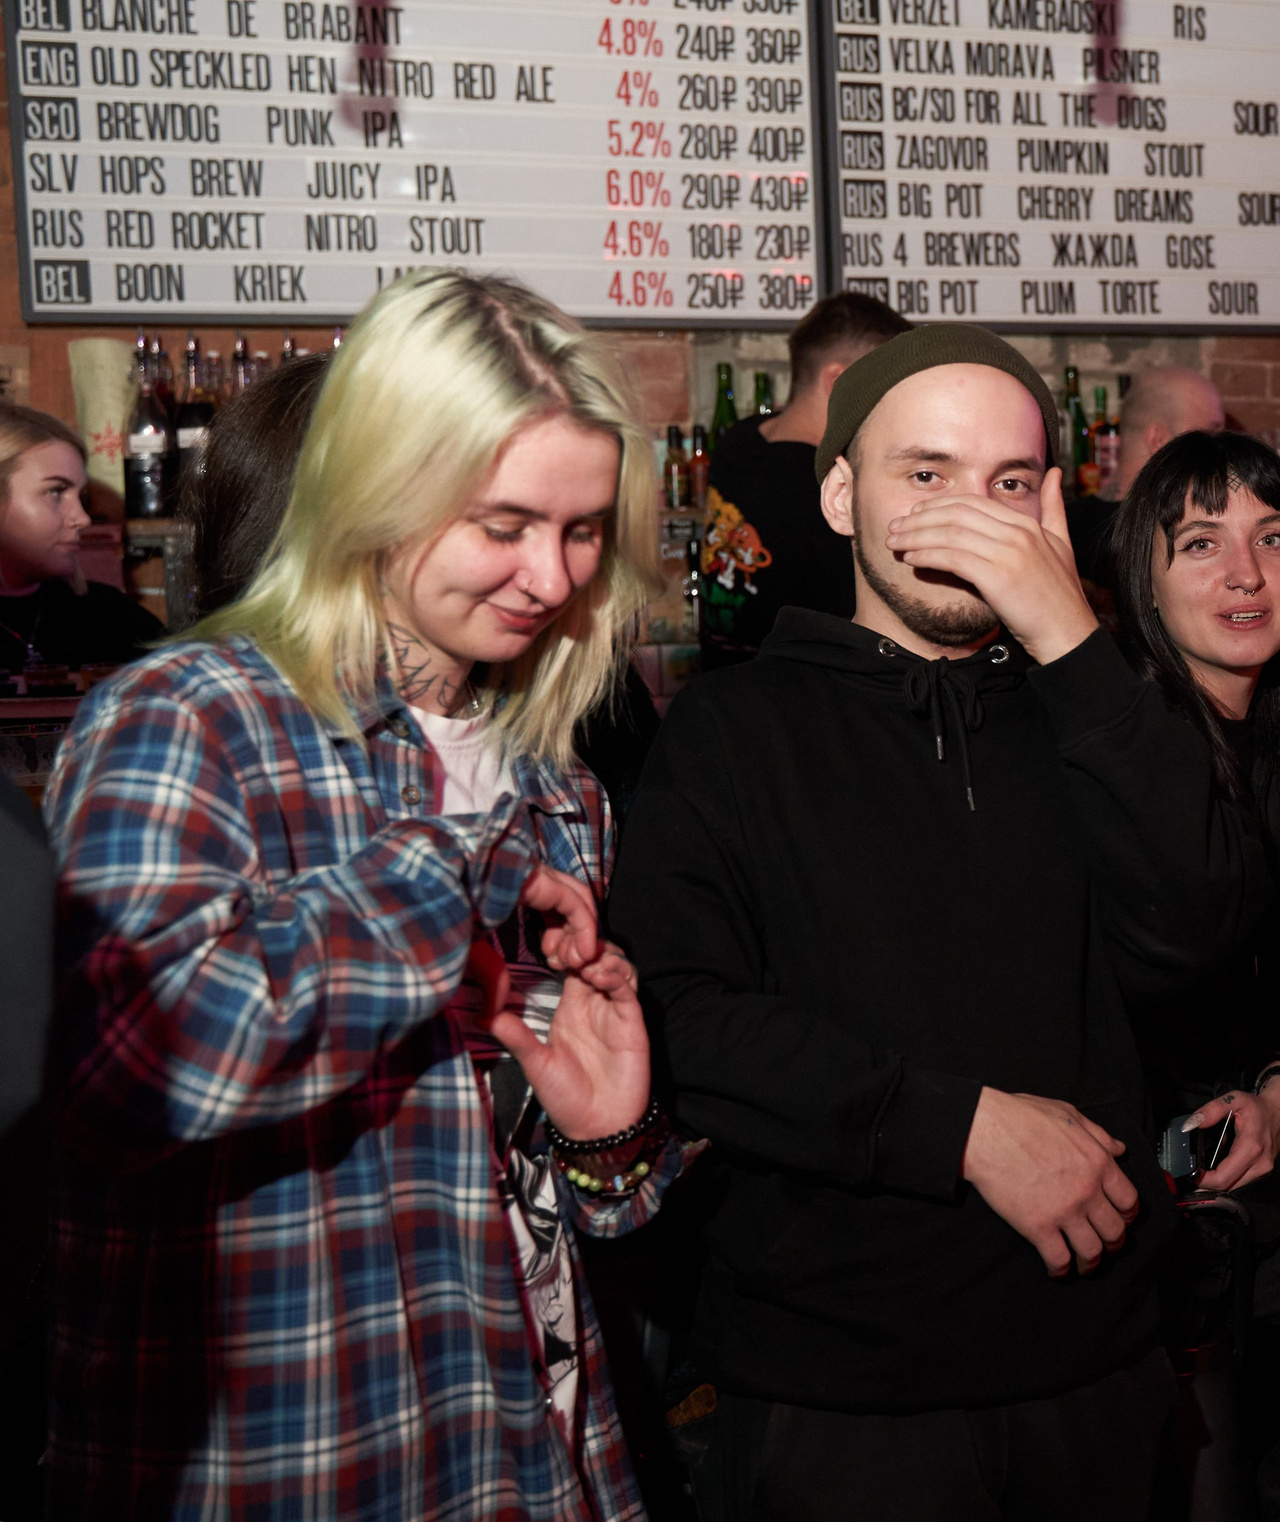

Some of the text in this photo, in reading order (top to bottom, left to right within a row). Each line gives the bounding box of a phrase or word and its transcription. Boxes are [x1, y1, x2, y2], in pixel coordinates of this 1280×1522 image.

[20, 0, 802, 64] BEL BLANCHE DE BRABANT 4.8% 240₽ 360₽
[888, 0, 960, 27] VERZET
[1174, 5, 1206, 41] RIS
[24, 46, 802, 113] ENG OLD SPECKLED HEN NITRO RED ALE 4% 260₽ 390₽
[839, 35, 880, 73] RUS
[889, 37, 955, 76] VELKA
[965, 41, 1055, 81] MORAVA
[1083, 47, 1160, 85] PILSNER
[26, 101, 806, 162] SCO BREWDOG PUNK IPA 5.2% 280₽ 400₽
[841, 85, 883, 122] RUS
[965, 89, 1001, 125] FOR
[1013, 91, 1048, 126] ALL
[1059, 92, 1098, 128] THE
[1117, 94, 1167, 132] DOGS
[1234, 101, 1278, 137] SOUR
[843, 134, 884, 170] RUS
[896, 136, 988, 172] ZAGOVOR
[1017, 139, 1109, 175] PUMPKIN
[1144, 143, 1205, 178] STOUT
[30, 153, 809, 212] SLV HOPS BREW JUICY IPA 6.0% 290₽ 430₽
[845, 183, 886, 219] RUS
[897, 182, 931, 218] BIG
[945, 184, 984, 219] POT
[1017, 185, 1095, 222] CHERRY
[1114, 188, 1194, 224] DREAMS
[32, 209, 811, 260] RUS RED ROCKET NITRO STOUT 4.6% 180₽ 230₽
[842, 233, 883, 267] RUS
[893, 233, 908, 267] 4
[924, 232, 1021, 268] BREWERS
[1166, 234, 1215, 270] GOSE
[40, 265, 86, 303] BEL
[115, 264, 186, 302] BOON
[234, 265, 307, 303] KRIEK
[608, 270, 674, 308] 4.6%
[687, 273, 743, 309] 250₽
[758, 273, 813, 310] 380₽
[897, 280, 929, 314] BIG
[940, 281, 978, 315] POT
[1021, 281, 1076, 315] PLUM
[1099, 281, 1161, 315] TORTE
[1208, 281, 1259, 316] SOUR
